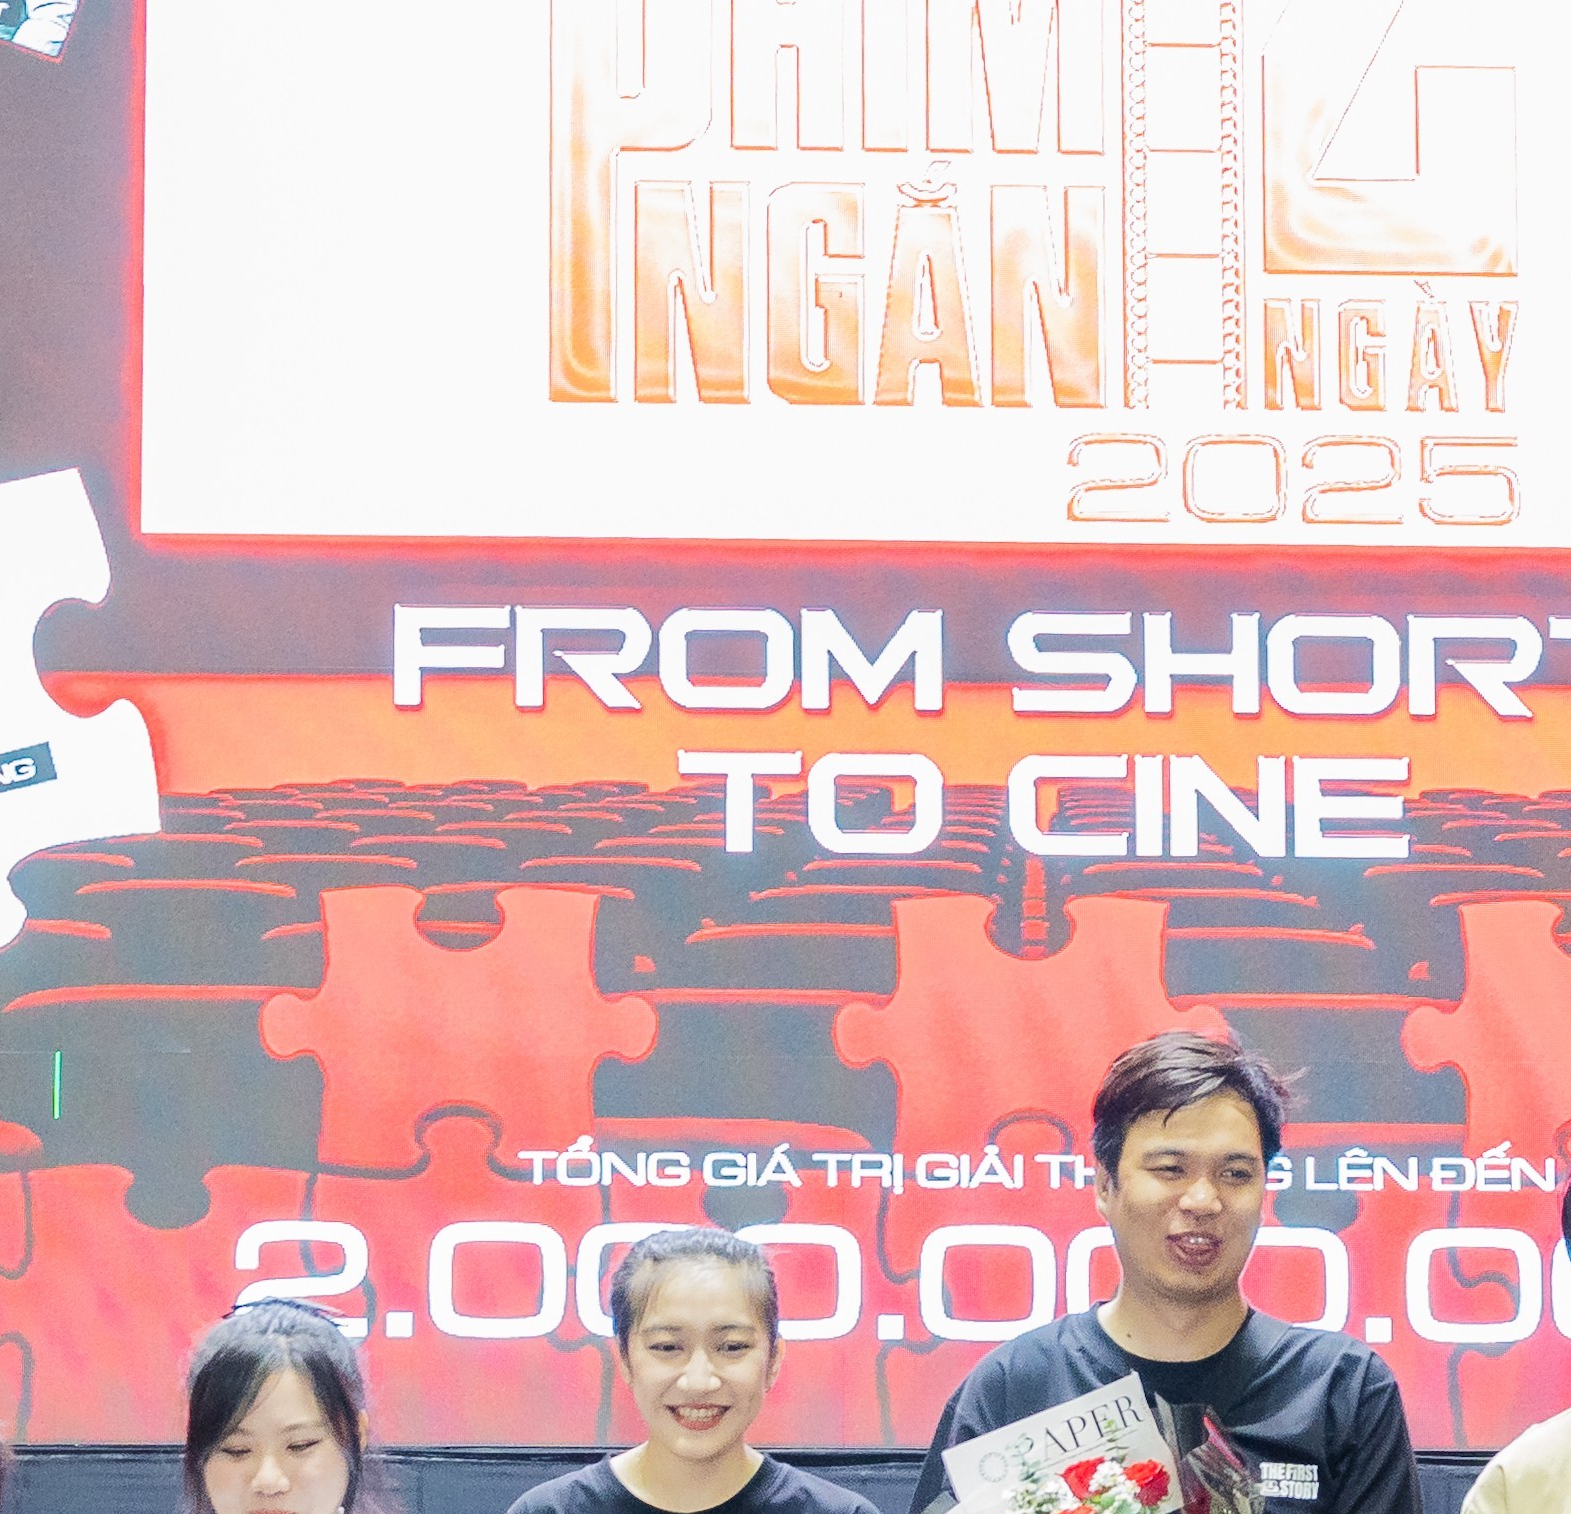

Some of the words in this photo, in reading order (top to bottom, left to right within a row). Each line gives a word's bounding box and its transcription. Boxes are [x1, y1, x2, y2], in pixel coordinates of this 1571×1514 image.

[634, 160, 1106, 408] NGẮN
[1263, 280, 1519, 412] NGÀY
[1067, 434, 1521, 525] 2025
[394, 605, 943, 713] FROM
[677, 750, 943, 855] TO
[1007, 754, 1410, 859] CINE
[519, 1135, 691, 1188] TỔNG
[702, 1141, 802, 1188] GIÁ
[812, 1151, 906, 1196] TRỊ
[916, 1143, 1023, 1190] GIẢI
[1305, 1149, 1422, 1192] LÊN
[1430, 1140, 1555, 1193] ĐẾN
[1259, 1462, 1286, 1480] THE
[1286, 1463, 1318, 1482] FIRST
[1279, 1479, 1320, 1500] STORY
